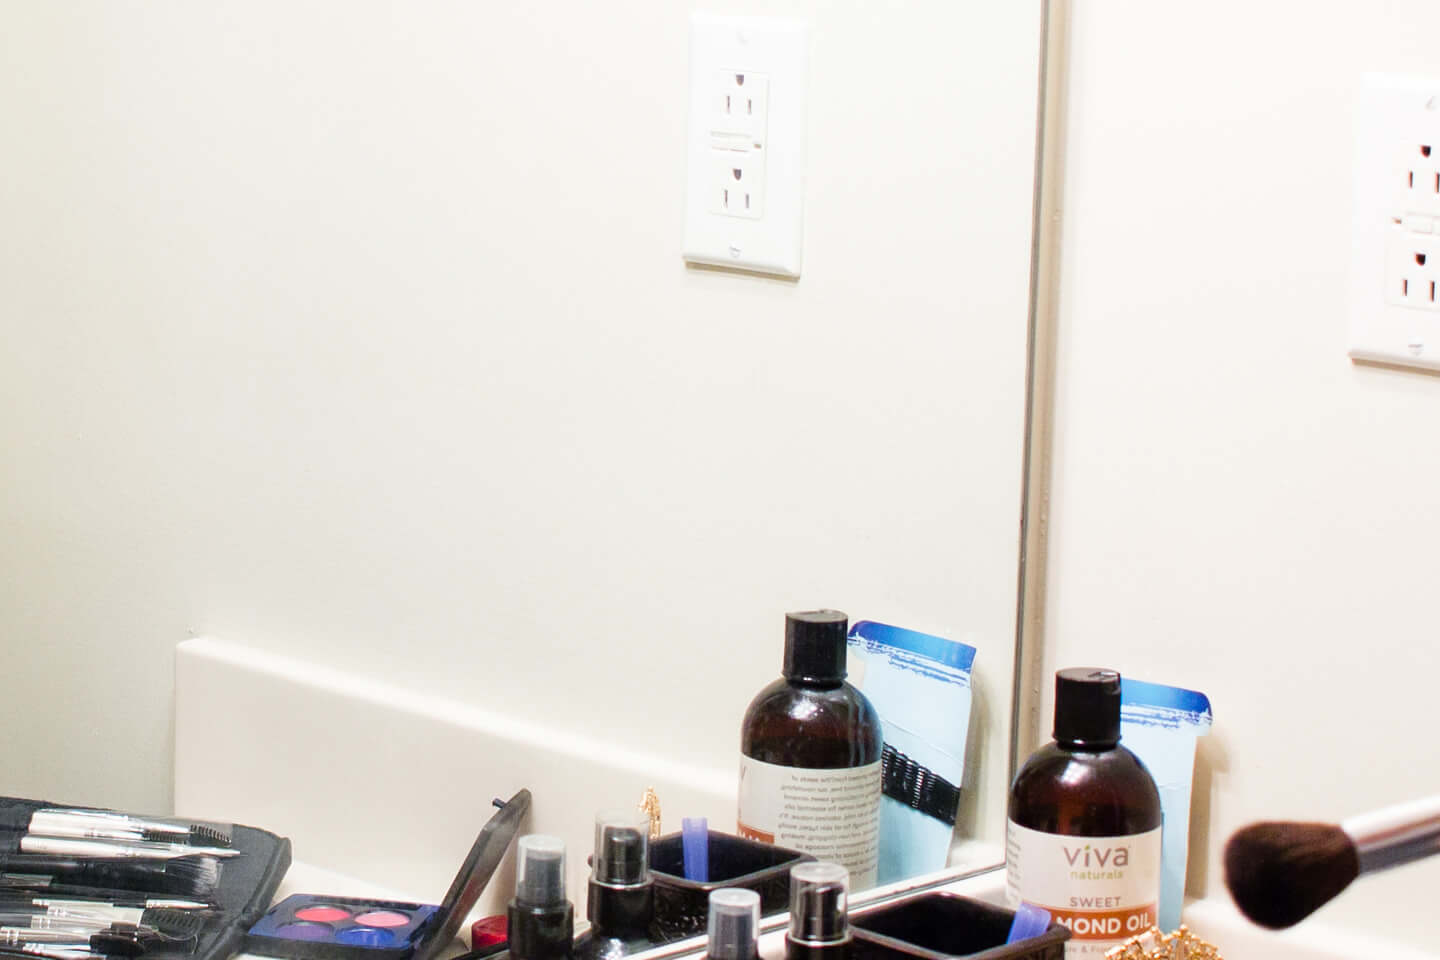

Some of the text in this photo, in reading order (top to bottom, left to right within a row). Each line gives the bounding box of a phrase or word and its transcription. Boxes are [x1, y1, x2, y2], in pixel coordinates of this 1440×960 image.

[1063, 844, 1129, 868] viva
[1070, 870, 1123, 880] naturals
[1069, 897, 1121, 908] SWEET
[1056, 912, 1152, 934] MOND OIL
